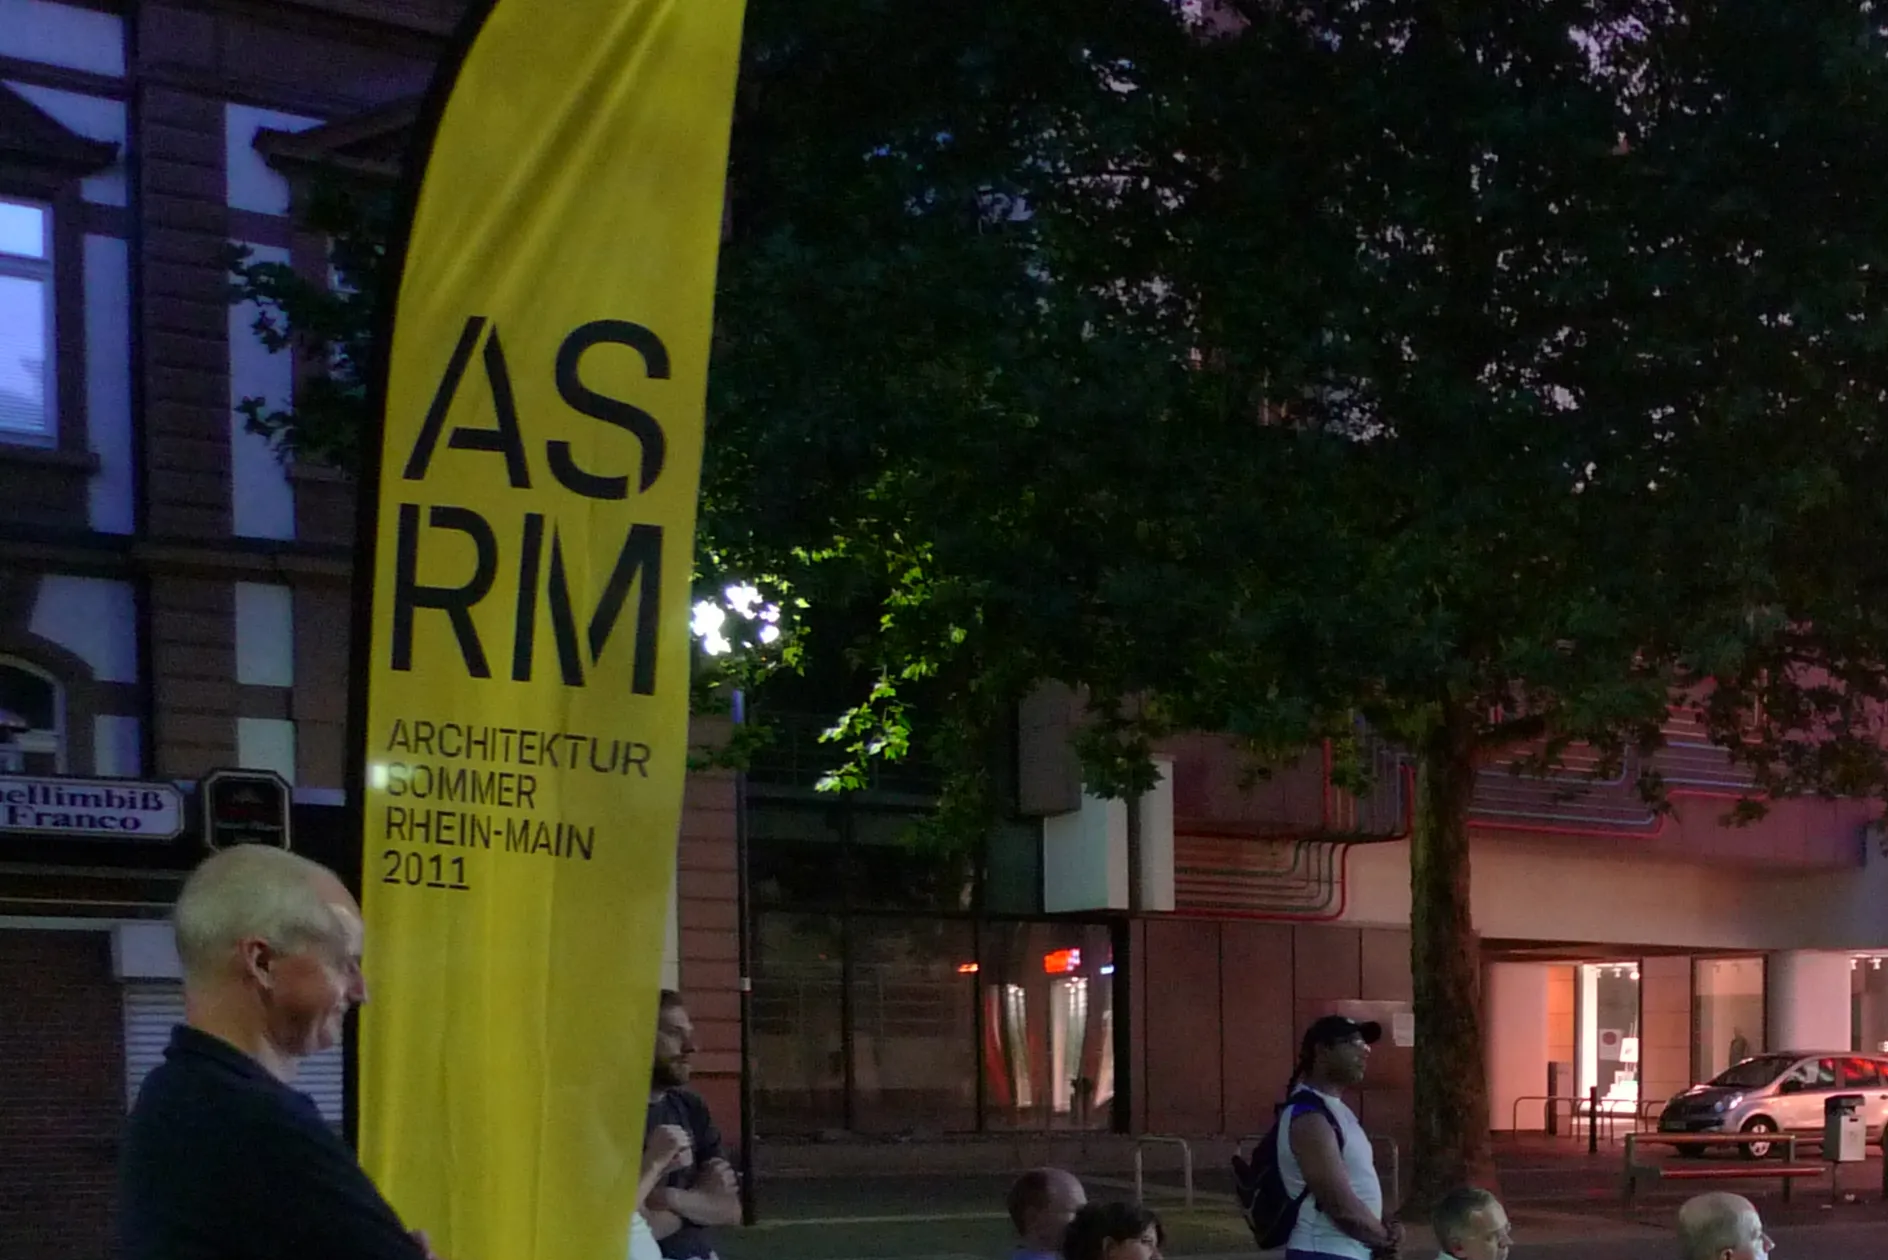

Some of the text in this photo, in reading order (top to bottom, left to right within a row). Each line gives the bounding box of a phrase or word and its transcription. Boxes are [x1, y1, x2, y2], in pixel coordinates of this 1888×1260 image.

[402, 315, 671, 500] AS
[391, 502, 664, 696] RM
[387, 718, 652, 778] ARCHITEKTUR
[0, 783, 164, 812] ellimbiß
[387, 761, 538, 809] SOMMER
[7, 805, 142, 832] Franco
[385, 805, 595, 861] RHEIN-MAIN
[382, 849, 470, 890] 2011
